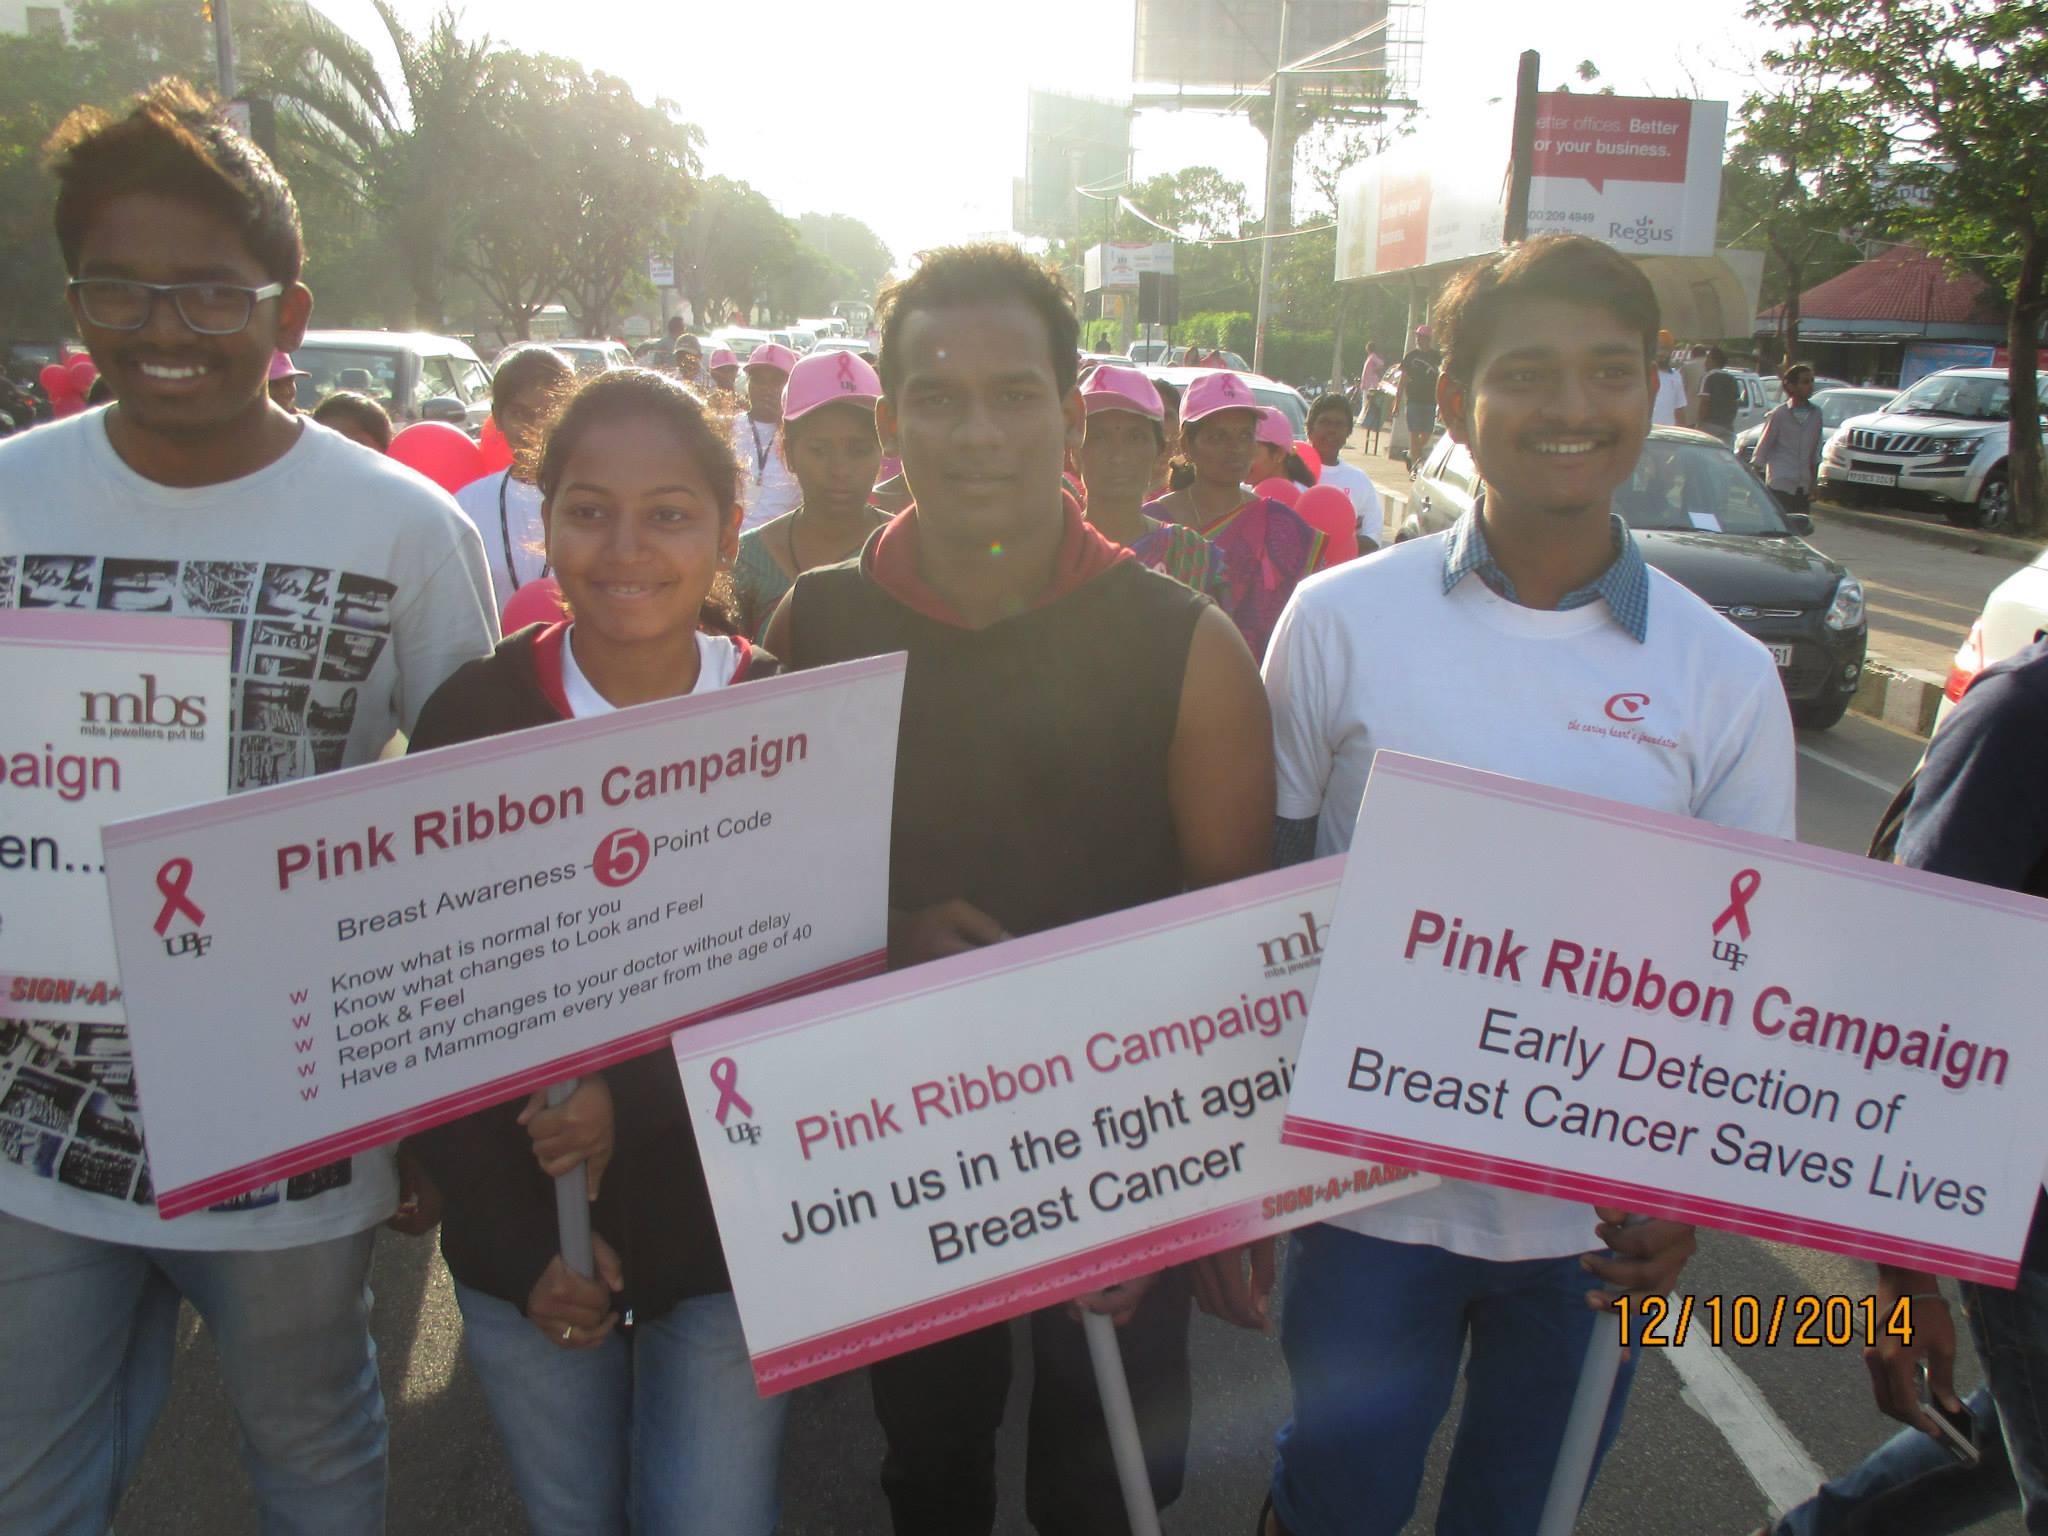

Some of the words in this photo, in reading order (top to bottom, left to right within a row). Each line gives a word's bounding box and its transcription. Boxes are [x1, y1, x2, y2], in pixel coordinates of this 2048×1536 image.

[1534, 139, 1552, 152] or
[1556, 141, 1592, 160] your
[1595, 140, 1671, 157] business.
[1536, 115, 1568, 130] etter
[1629, 117, 1680, 135] Better
[1528, 210, 1545, 222] 00
[1545, 210, 1567, 222] 209
[1608, 221, 1674, 245] Regus
[80, 674, 207, 727] mbs
[80, 725, 106, 735] mbs
[109, 726, 164, 740] jewellers
[168, 728, 187, 742] pvt
[190, 728, 205, 741] ltd
[277, 826, 396, 891] Pink
[414, 785, 584, 856] Ribbon
[601, 733, 808, 807] Campaign
[0, 835, 105, 872] en...
[338, 899, 427, 941] Breast
[436, 863, 576, 915] Awareness
[653, 825, 709, 857] Point
[717, 810, 772, 838] Code
[162, 931, 213, 958] UBF
[331, 964, 393, 993] Know
[401, 944, 452, 973] what
[459, 940, 475, 957] is
[482, 915, 550, 950] normal
[557, 910, 582, 930] for
[588, 899, 621, 924] you
[334, 988, 395, 1018] Know
[403, 969, 454, 997] what
[460, 943, 545, 980] changes
[552, 935, 570, 953] to
[576, 920, 622, 946] Look
[627, 907, 660, 931] and
[666, 894, 704, 920] Feel
[1257, 912, 1330, 967] mb
[1711, 939, 1748, 971] UBF
[336, 1012, 390, 1042] Look
[397, 1005, 412, 1022] &
[420, 988, 465, 1016] Feel
[339, 1029, 412, 1066] Report
[419, 1018, 456, 1041] any
[463, 989, 547, 1026] changes
[554, 982, 571, 999] to
[577, 967, 618, 995] your
[623, 948, 678, 977] doctor
[683, 926, 744, 957] without
[748, 912, 792, 937] delay
[341, 1060, 397, 1089] Have
[405, 1055, 417, 1069] a
[425, 1008, 556, 1063] Mammogram
[562, 991, 613, 1019] every
[619, 976, 659, 1004] year
[664, 962, 701, 986] from
[707, 952, 733, 971] the
[738, 942, 768, 961] age
[773, 931, 789, 949] of
[792, 922, 812, 940] 40
[1403, 908, 1529, 983] Pink
[1541, 938, 1735, 1026] Ribbon
[1751, 985, 2010, 1090] Campaign
[795, 1098, 903, 1162] Pink
[911, 1054, 1074, 1126] Ribbon
[1085, 988, 1308, 1073] Campaign
[1478, 1007, 1606, 1081] Early
[1617, 1036, 1840, 1122] Detection
[1854, 1094, 1907, 1134] of
[723, 1122, 763, 1145] UBF
[782, 1187, 877, 1245] Join
[891, 1169, 947, 1210] us
[956, 1150, 1001, 1190] in
[1009, 1129, 1082, 1173] the
[1092, 1088, 1191, 1151] fight
[1200, 1057, 1296, 1118] agai
[1347, 1046, 1510, 1120] Breast
[1524, 1085, 1699, 1157] Cancer
[1710, 1122, 1855, 1189] Saves
[1868, 1154, 1988, 1217] Lives
[928, 1185, 1079, 1265] Breast
[1089, 1140, 1246, 1212] Cancer
